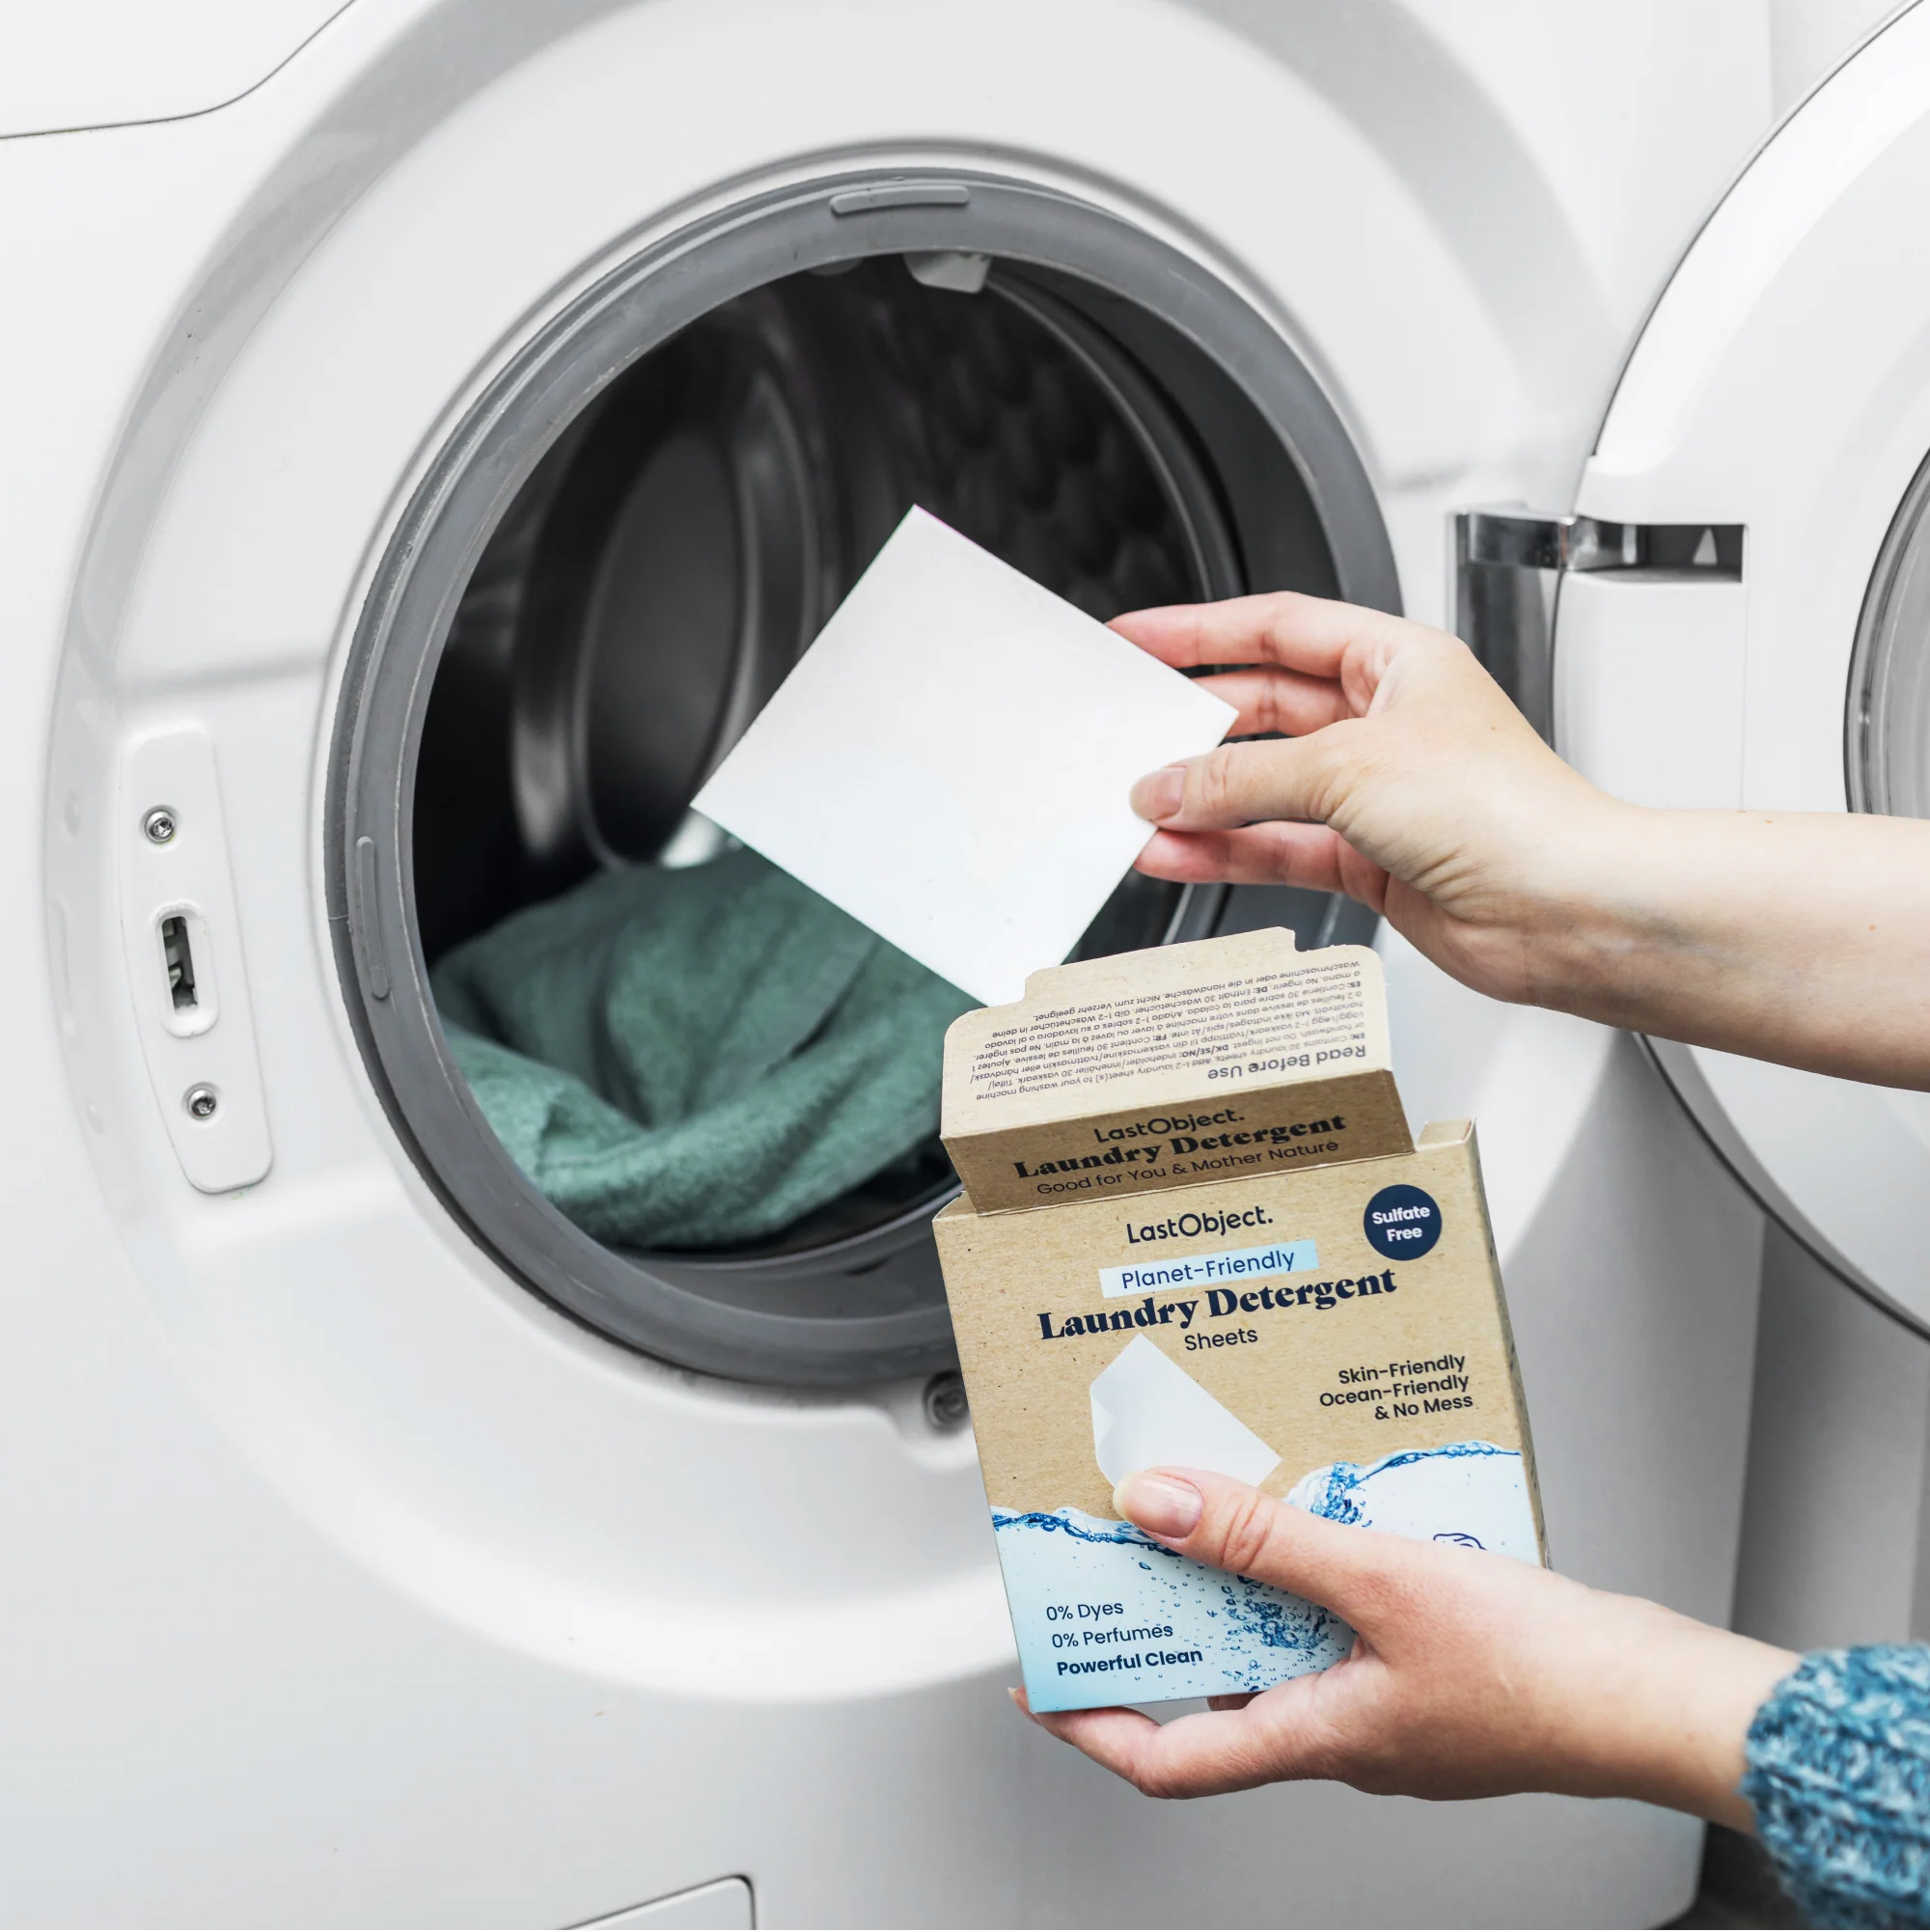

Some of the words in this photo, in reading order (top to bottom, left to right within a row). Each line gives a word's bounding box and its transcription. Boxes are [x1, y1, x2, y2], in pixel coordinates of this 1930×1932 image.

[1227, 980, 1242, 989] die
[1254, 974, 1277, 984] oder
[1345, 980, 1361, 989] ES:
[1252, 985, 1268, 995] DE:
[1113, 998, 1134, 1007] zum
[1135, 994, 1160, 1005] Nicht
[1232, 995, 1256, 1007] para
[1257, 992, 1285, 1004] sobre
[1032, 1007, 1075, 1023] geeignet.
[1077, 1002, 1112, 1015] Verzehr
[1113, 1008, 1130, 1018] Gib
[1184, 1004, 1220, 1016] colada.
[1235, 1007, 1259, 1018] dans
[1097, 1011, 1112, 1021] 1-2
[1135, 1015, 1149, 1025] 1-2
[1208, 1011, 1233, 1022] votre
[1101, 1018, 1133, 1031] sobres
[1165, 1016, 1207, 1030] machine
[991, 1028, 1017, 1038] deine
[1035, 1028, 1078, 1041] lavadora
[1130, 1025, 1154, 1035] laver
[1089, 1032, 1115, 1042] lavez
[1110, 1035, 1150, 1049] Contient
[1151, 1033, 1167, 1041] FR:
[1189, 1037, 1199, 1046] til
[983, 1038, 1016, 1050] lavado
[1008, 1044, 1027, 1054] pas
[1042, 1039, 1069, 1050] main.
[1061, 1044, 1094, 1057] feuilles
[1172, 1039, 1187, 1049] din
[1177, 1041, 1228, 1058] DK/SE/NO:
[1012, 1053, 1046, 1064] lessive.
[1314, 1043, 1366, 1064] Read
[977, 1056, 1011, 1070] Ajoutez
[1137, 1061, 1173, 1075] laundry
[1174, 1060, 1190, 1069] 1-2
[1192, 1057, 1211, 1066] Add
[1247, 1053, 1310, 1075] Before
[1020, 1063, 1040, 1074] eller
[1094, 1067, 1135, 1082] sheet(s)
[1206, 1063, 1242, 1082] Use
[986, 1076, 1012, 1089] Tilføj/
[1014, 1070, 1059, 1085] vaskeark.
[1060, 1076, 1081, 1087] your
[1018, 1079, 1058, 1094] washing
[975, 1088, 1016, 1101] machine
[1094, 1109, 1245, 1144] LastObject.
[1012, 1145, 1162, 1178] Laundry
[1169, 1115, 1346, 1155] Detergent
[1036, 1177, 1091, 1194] Good
[1095, 1173, 1123, 1187] for
[1127, 1167, 1167, 1180] You
[1172, 1163, 1187, 1174] &
[1191, 1152, 1262, 1172] Mother
[1268, 1142, 1339, 1161] Nature
[1371, 1205, 1430, 1225] Sulfate
[1126, 1205, 1274, 1244] LastObject.
[1386, 1227, 1422, 1242] Free
[1121, 1250, 1295, 1289] Planet-Friendly
[1036, 1297, 1199, 1339] Laundry
[1204, 1268, 1397, 1318] Detergent
[1183, 1328, 1258, 1351] Sheets
[1338, 1354, 1465, 1384] Skin-Friendly
[1319, 1374, 1469, 1407] Ocean-Friendly
[1374, 1405, 1390, 1420] &
[1392, 1402, 1420, 1418] No
[1423, 1395, 1474, 1414] Mess
[1046, 1605, 1074, 1621] 0%
[1077, 1602, 1124, 1621] Dyes
[1051, 1633, 1079, 1648] 0%
[1083, 1625, 1173, 1646] Perfumes
[1056, 1653, 1143, 1676] Powerful
[1144, 1649, 1203, 1667] Clean
